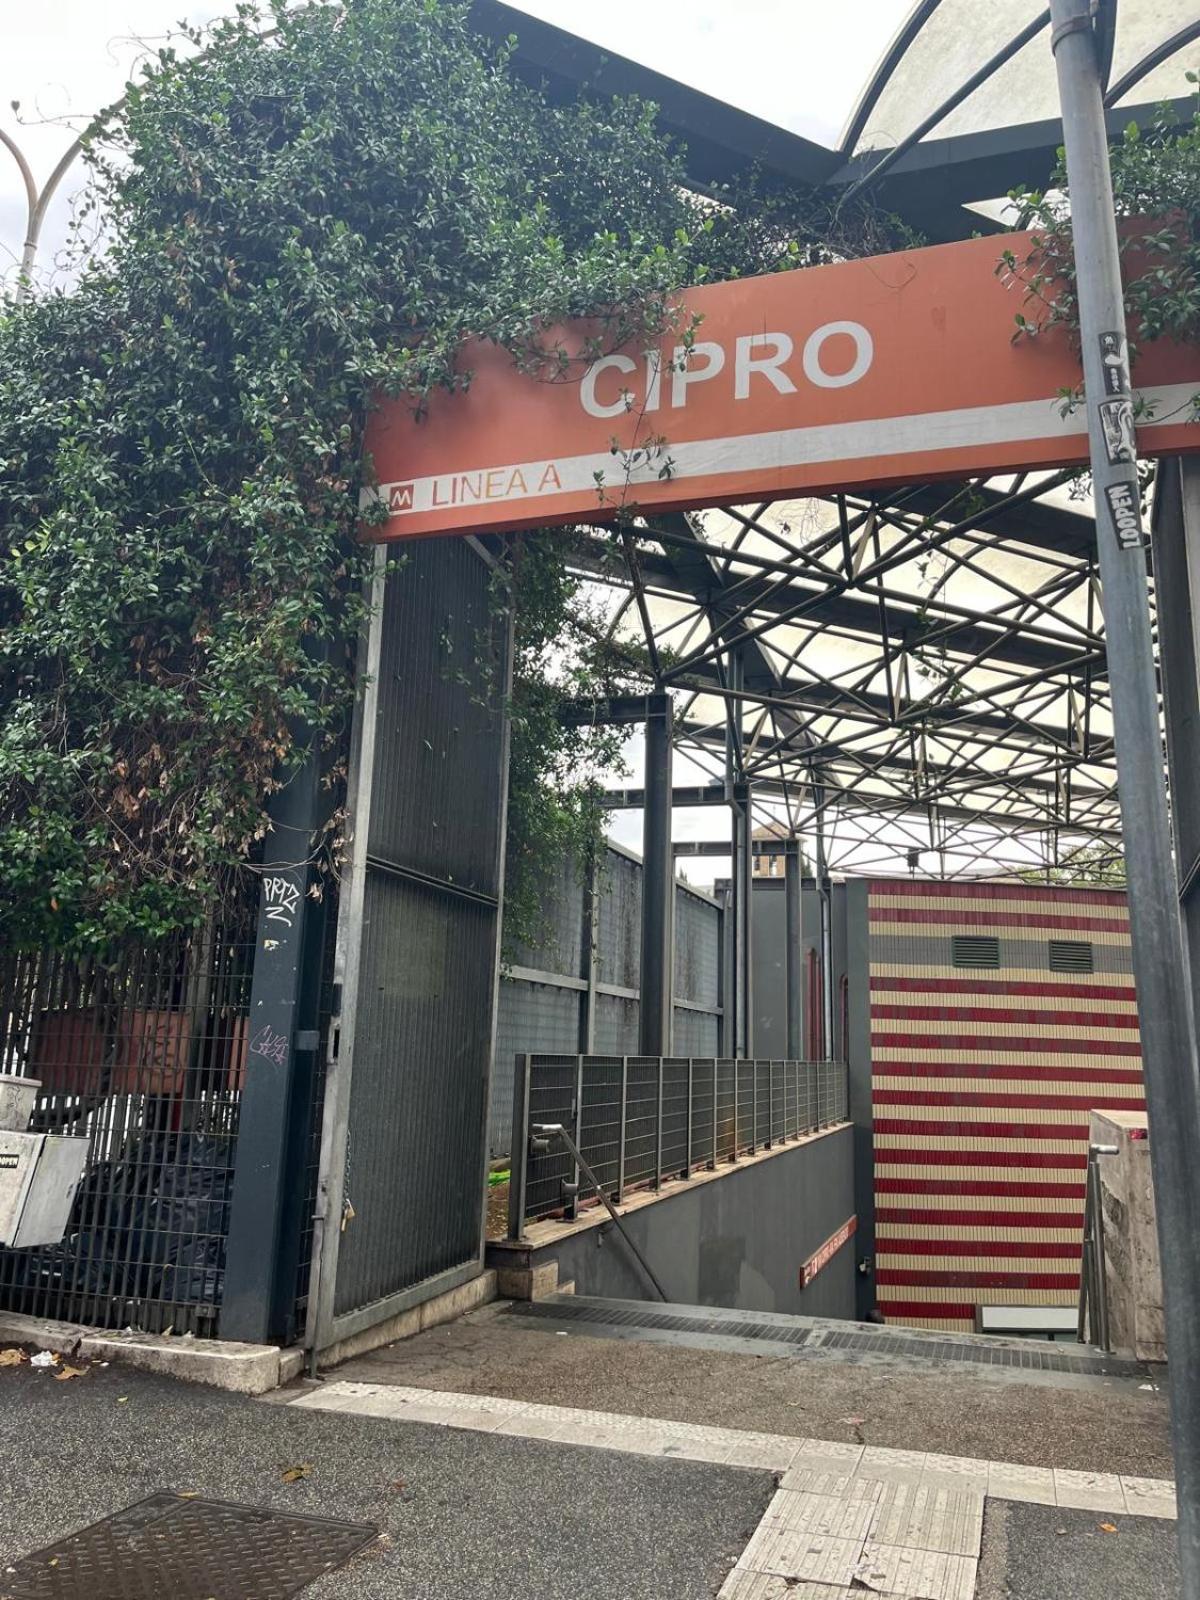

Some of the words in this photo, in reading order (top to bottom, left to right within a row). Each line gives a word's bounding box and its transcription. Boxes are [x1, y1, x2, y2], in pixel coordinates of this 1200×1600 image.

[580, 320, 875, 419] CIPRO
[432, 469, 528, 506] LINEA
[538, 463, 562, 492] A
[1108, 484, 1141, 549] LOOPEN
